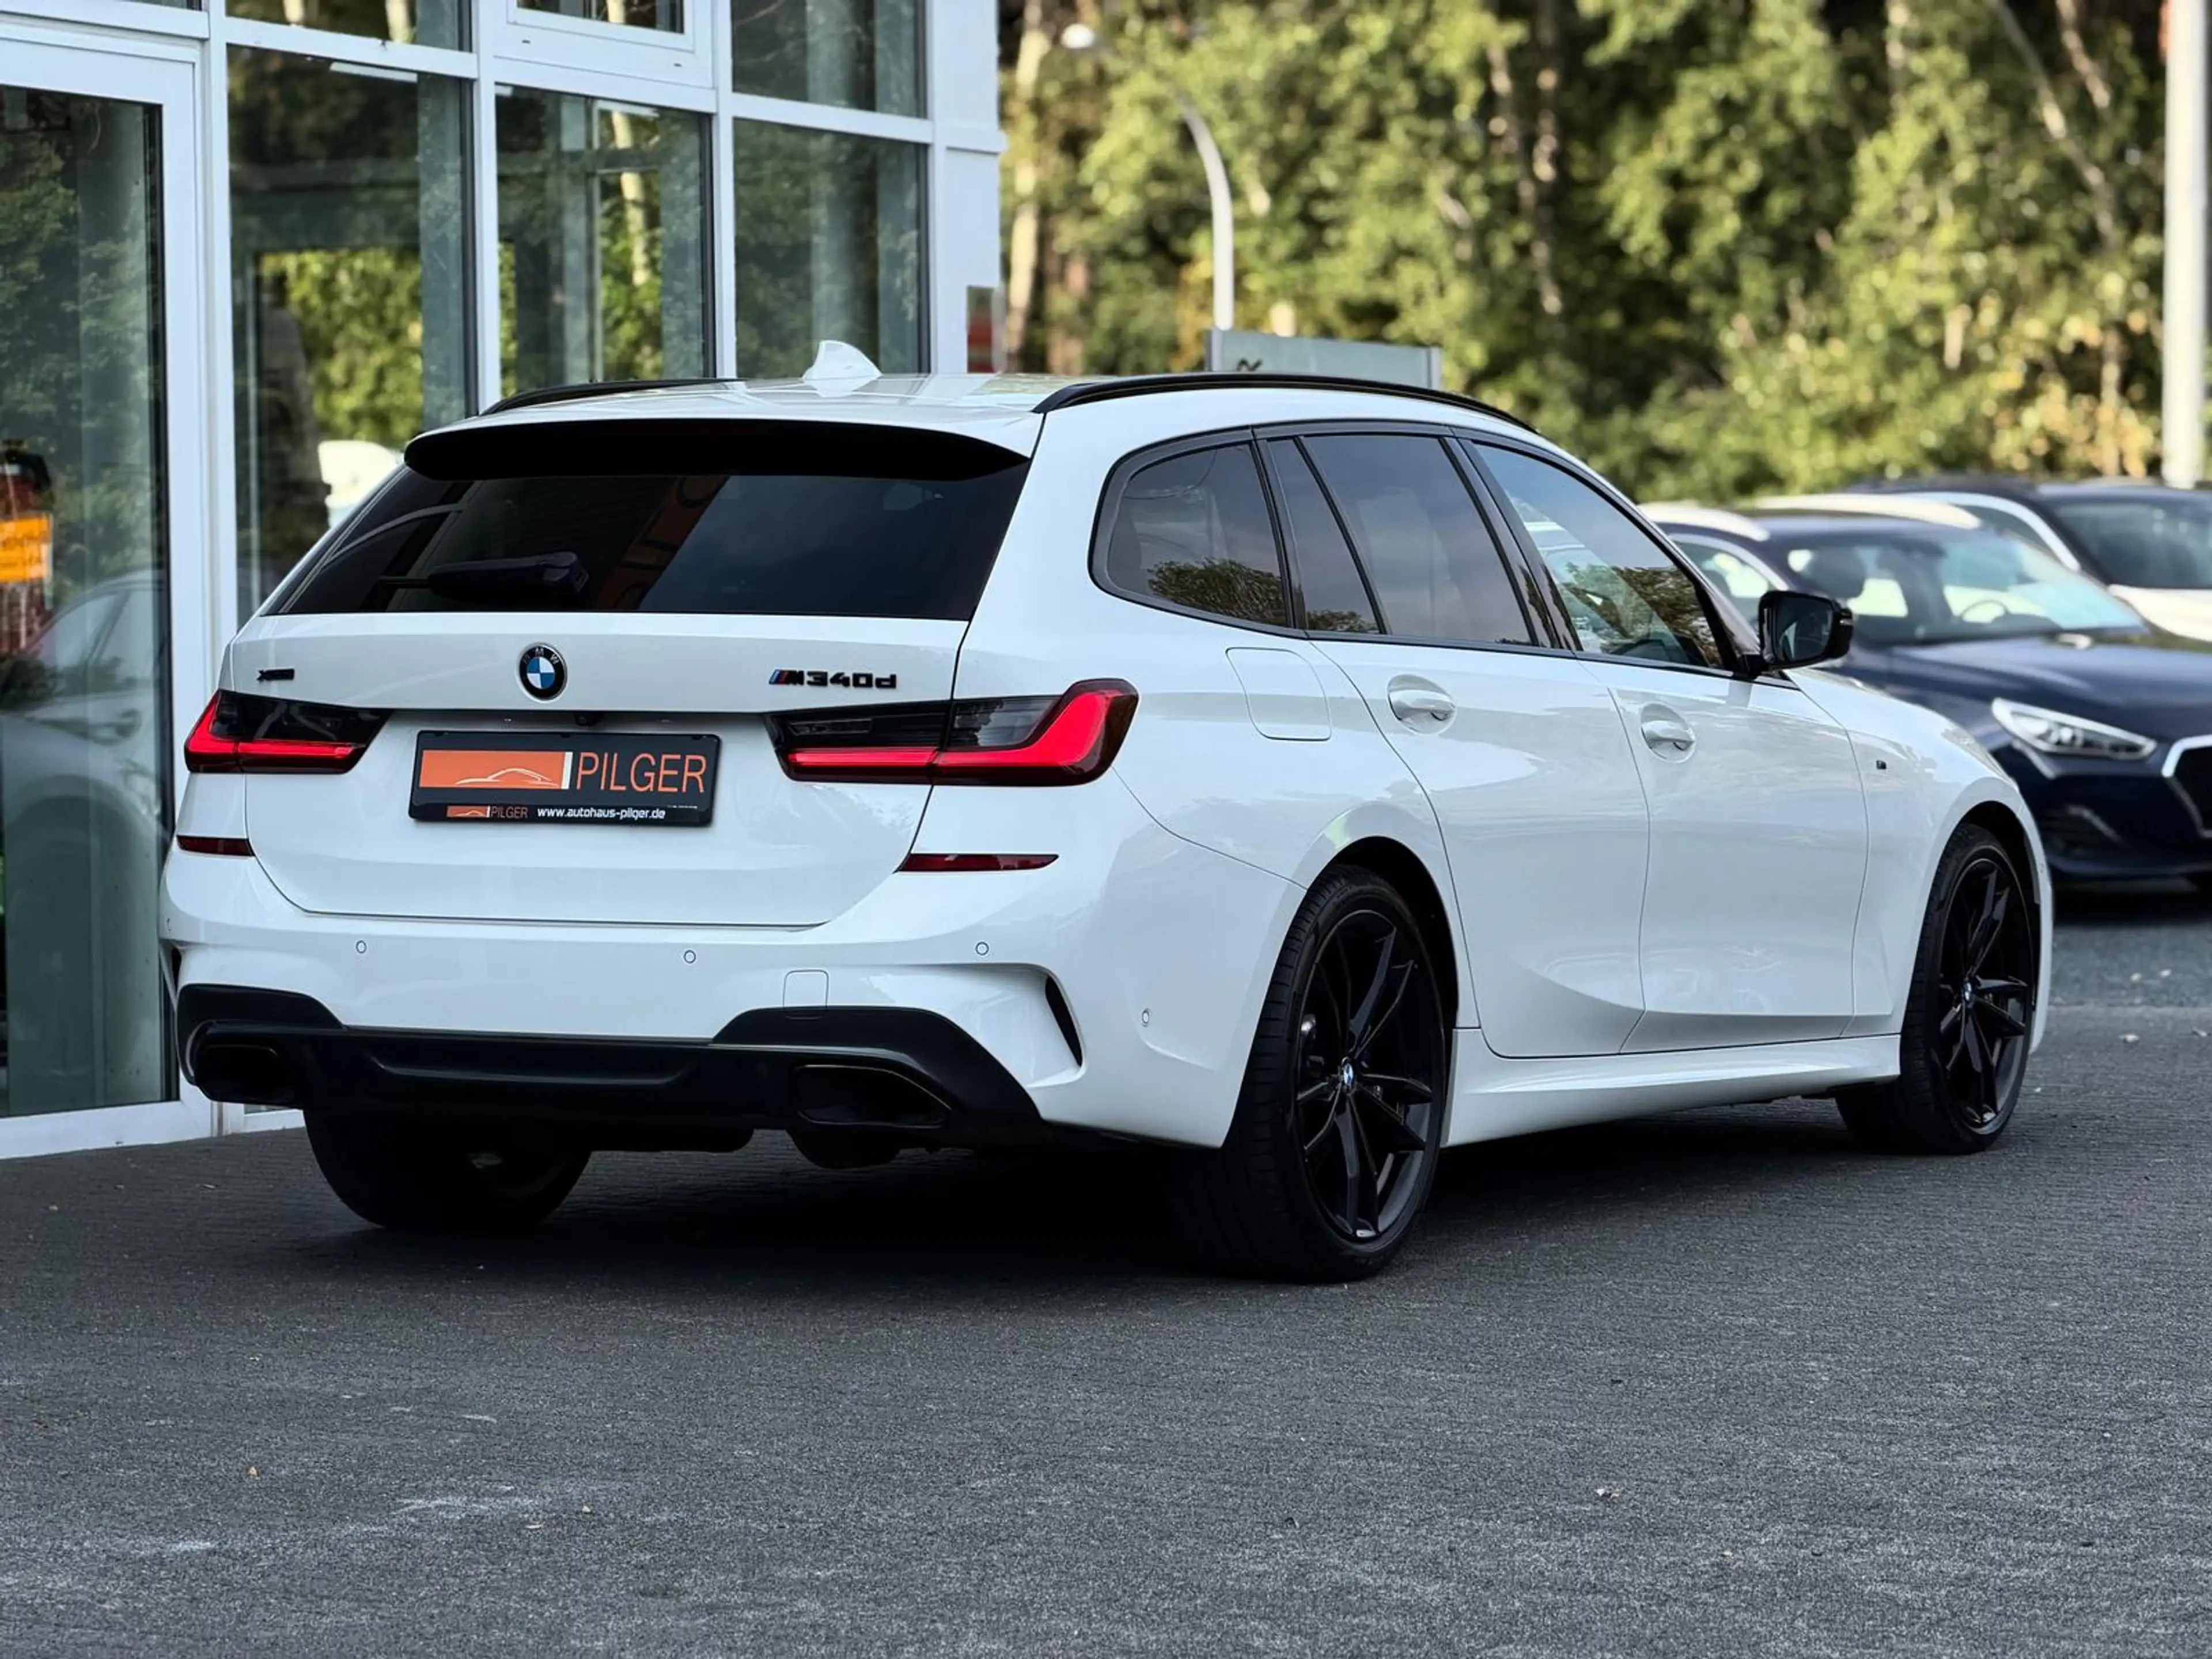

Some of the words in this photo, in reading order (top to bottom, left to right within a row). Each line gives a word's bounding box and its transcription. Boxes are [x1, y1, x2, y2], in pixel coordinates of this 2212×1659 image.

[770, 669, 896, 689] M340d
[577, 752, 706, 793] PILGER
[491, 806, 528, 818] PILGER
[537, 807, 666, 820] www.autohaus-pilger.de
